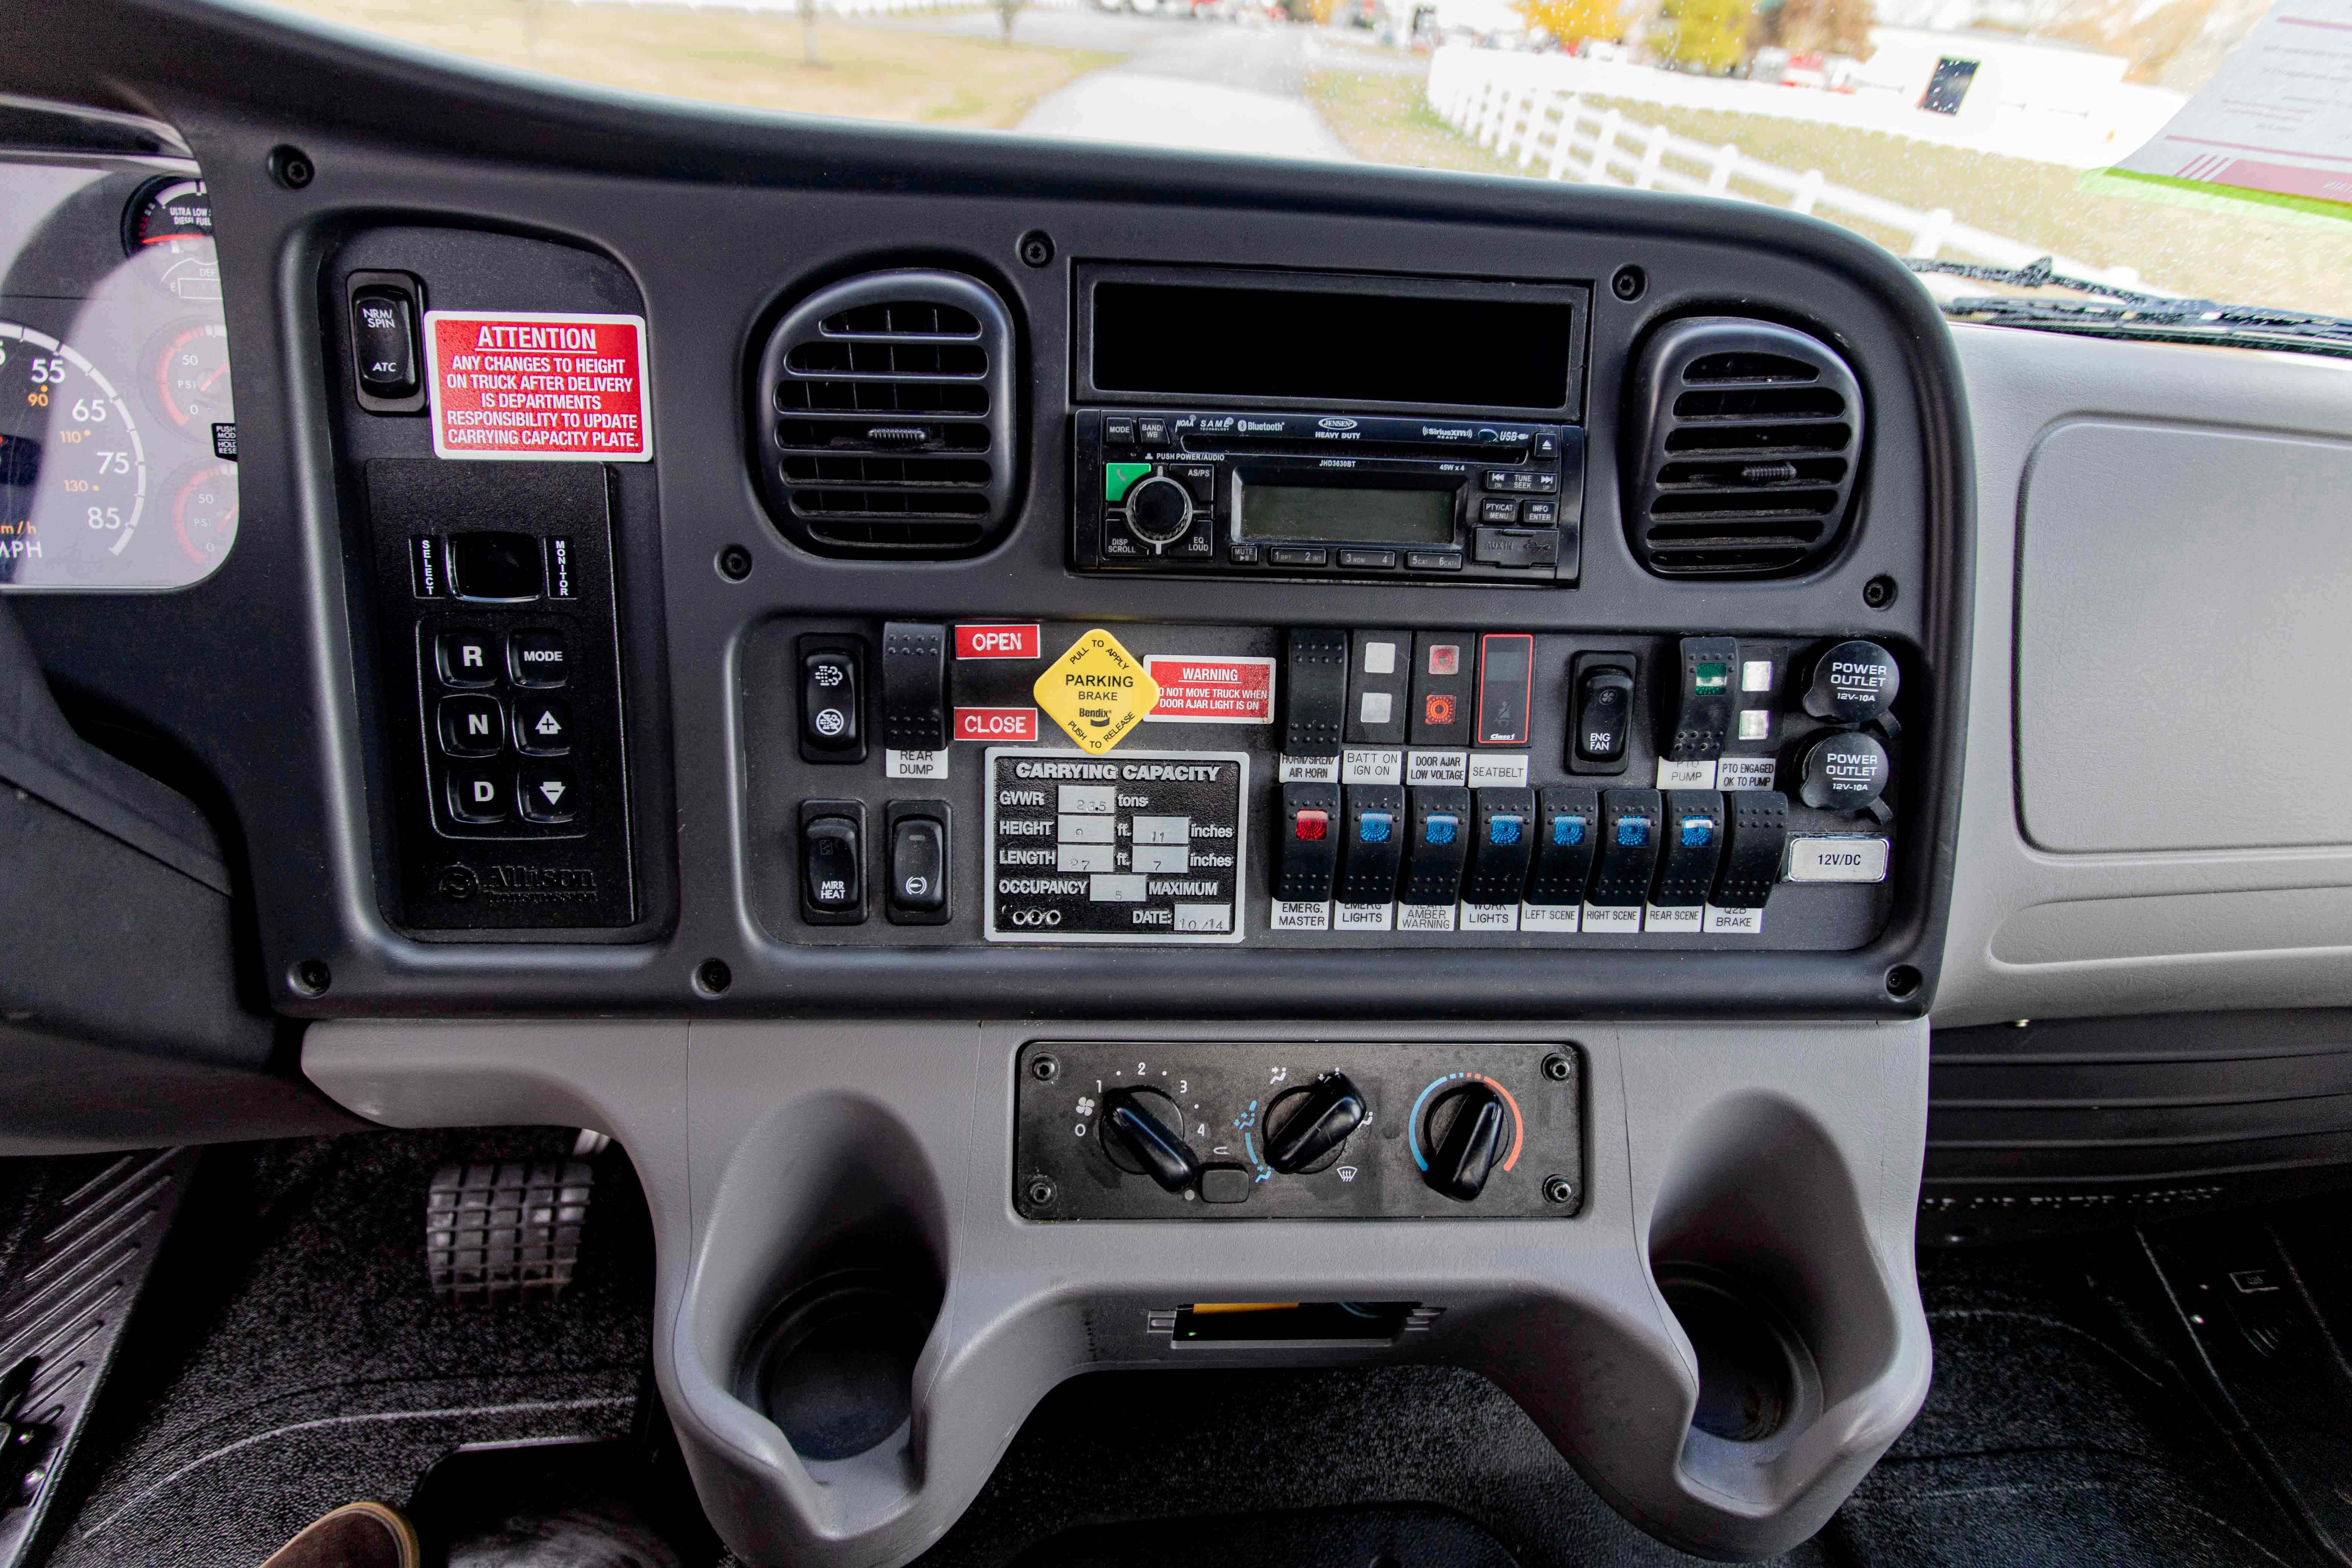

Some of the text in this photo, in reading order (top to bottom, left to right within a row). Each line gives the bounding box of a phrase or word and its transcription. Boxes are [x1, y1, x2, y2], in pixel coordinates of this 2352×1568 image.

[170, 207, 191, 216] ULTRA
[193, 208, 207, 216] LOW
[363, 309, 392, 320] NRM/
[368, 318, 395, 328] SPIN
[478, 326, 596, 349] ATTENTION
[182, 355, 198, 366] 50
[452, 356, 625, 374] ANY CHANGES TO HEIGHT
[31, 358, 66, 383] 55
[372, 362, 397, 372] ATC
[178, 381, 196, 389] PSI
[447, 374, 633, 392] ON TRUCK AFTER DELIVERY
[28, 393, 49, 407] 90
[482, 394, 602, 410] IS DEPARTMENTS
[72, 398, 106, 422] 65
[190, 405, 199, 414] 0
[447, 410, 637, 429] RESPONSIBILITY TO UPDATE
[1248, 422, 1283, 431] Bluetooth
[60, 431, 81, 443] 110
[448, 429, 639, 447] CARRYING CAPACITY PLATE.
[1499, 431, 1517, 441] USB
[96, 452, 130, 474] 75
[1319, 459, 1356, 468] JHD3630BT
[1188, 469, 1210, 477] AS/PS
[63, 479, 89, 492] 130
[198, 494, 214, 504] 50
[1486, 503, 1514, 511] PTY/CAT
[87, 507, 121, 530] 85
[1193, 536, 1204, 545] EQ
[1484, 541, 1513, 550] AUX IN
[1108, 545, 1136, 553] SCROLL
[1188, 544, 1209, 552] LOUD
[1275, 552, 1279, 560] 1
[1305, 552, 1311, 561] 2
[1346, 553, 1351, 563] 3
[1382, 555, 1387, 564] 4
[1413, 556, 1418, 564] 5
[422, 540, 434, 595] SELECT
[556, 541, 569, 596] MONITOR
[972, 633, 1021, 651] OPEN
[463, 646, 483, 666] R
[524, 651, 563, 662] MODE
[1070, 647, 1089, 664] PULL
[1106, 648, 1130, 670] APPLY
[1182, 668, 1238, 681] WARNING
[1832, 662, 1887, 676] POWER
[1065, 674, 1134, 688] PARKING
[1830, 674, 1886, 688] OUTLET
[1078, 691, 1118, 701] BRAKE
[1167, 688, 1267, 699] NOT MOVE TRUCK WHEN
[1836, 693, 1876, 702] 12V-10A
[1160, 699, 1259, 710] DOOR AJAR LIGHT IS ON
[468, 714, 489, 735] N
[965, 715, 1026, 733] CLOSE
[1067, 721, 1087, 741] PUSH
[1104, 712, 1135, 742] RELEASE
[1589, 732, 1611, 742] ENG
[1589, 741, 1609, 751] FAN
[900, 750, 933, 761] REAR
[1347, 753, 1398, 764] BATT ON
[1827, 753, 1878, 765] POWER
[1416, 756, 1461, 767] DOOR AJAR
[900, 764, 934, 775] DUMP
[1016, 763, 1221, 781] CARRYING CAPACITY
[1289, 767, 1328, 778] AIR HORN
[1354, 766, 1390, 776] IGN ON
[1411, 769, 1465, 780] LOW VOLTAGE
[1473, 766, 1524, 778] SEATBELT
[1722, 764, 1774, 774] PTO ENGAGED
[1826, 765, 1878, 776] OUTLET
[1671, 772, 1702, 781] PUMP
[1724, 777, 1771, 787] OK TO PUMP
[473, 781, 495, 802] D
[1832, 782, 1868, 791] 12V-10A
[999, 791, 1148, 807] GVWR tons
[999, 820, 1233, 838] HEIGHT inches
[999, 850, 1233, 871] LENGTH 27 7 inches
[1818, 854, 1861, 866] 12V/DC
[821, 881, 844, 890] MIRR
[999, 879, 1217, 896] OCCUPANCY MAXIMUM
[821, 890, 845, 899] HEAT
[1282, 903, 1323, 913] EMERG.
[1342, 913, 1383, 923] LIGHTS
[1407, 910, 1446, 919] AMBER
[1469, 914, 1509, 923] LIGHTS
[1525, 910, 1575, 920] LEFT SCENE
[1586, 910, 1637, 920] RIGHT SCENE
[1650, 911, 1699, 920] REAR SCENE
[1279, 916, 1325, 926] MASTER
[1403, 919, 1450, 929] WARNING
[1716, 917, 1751, 927] BRAKE
[1138, 1062, 1146, 1075] 2
[1096, 1080, 1102, 1093] 1
[1180, 1080, 1188, 1093] 3
[1075, 1123, 1086, 1136] 0
[1197, 1123, 1205, 1136] 4
